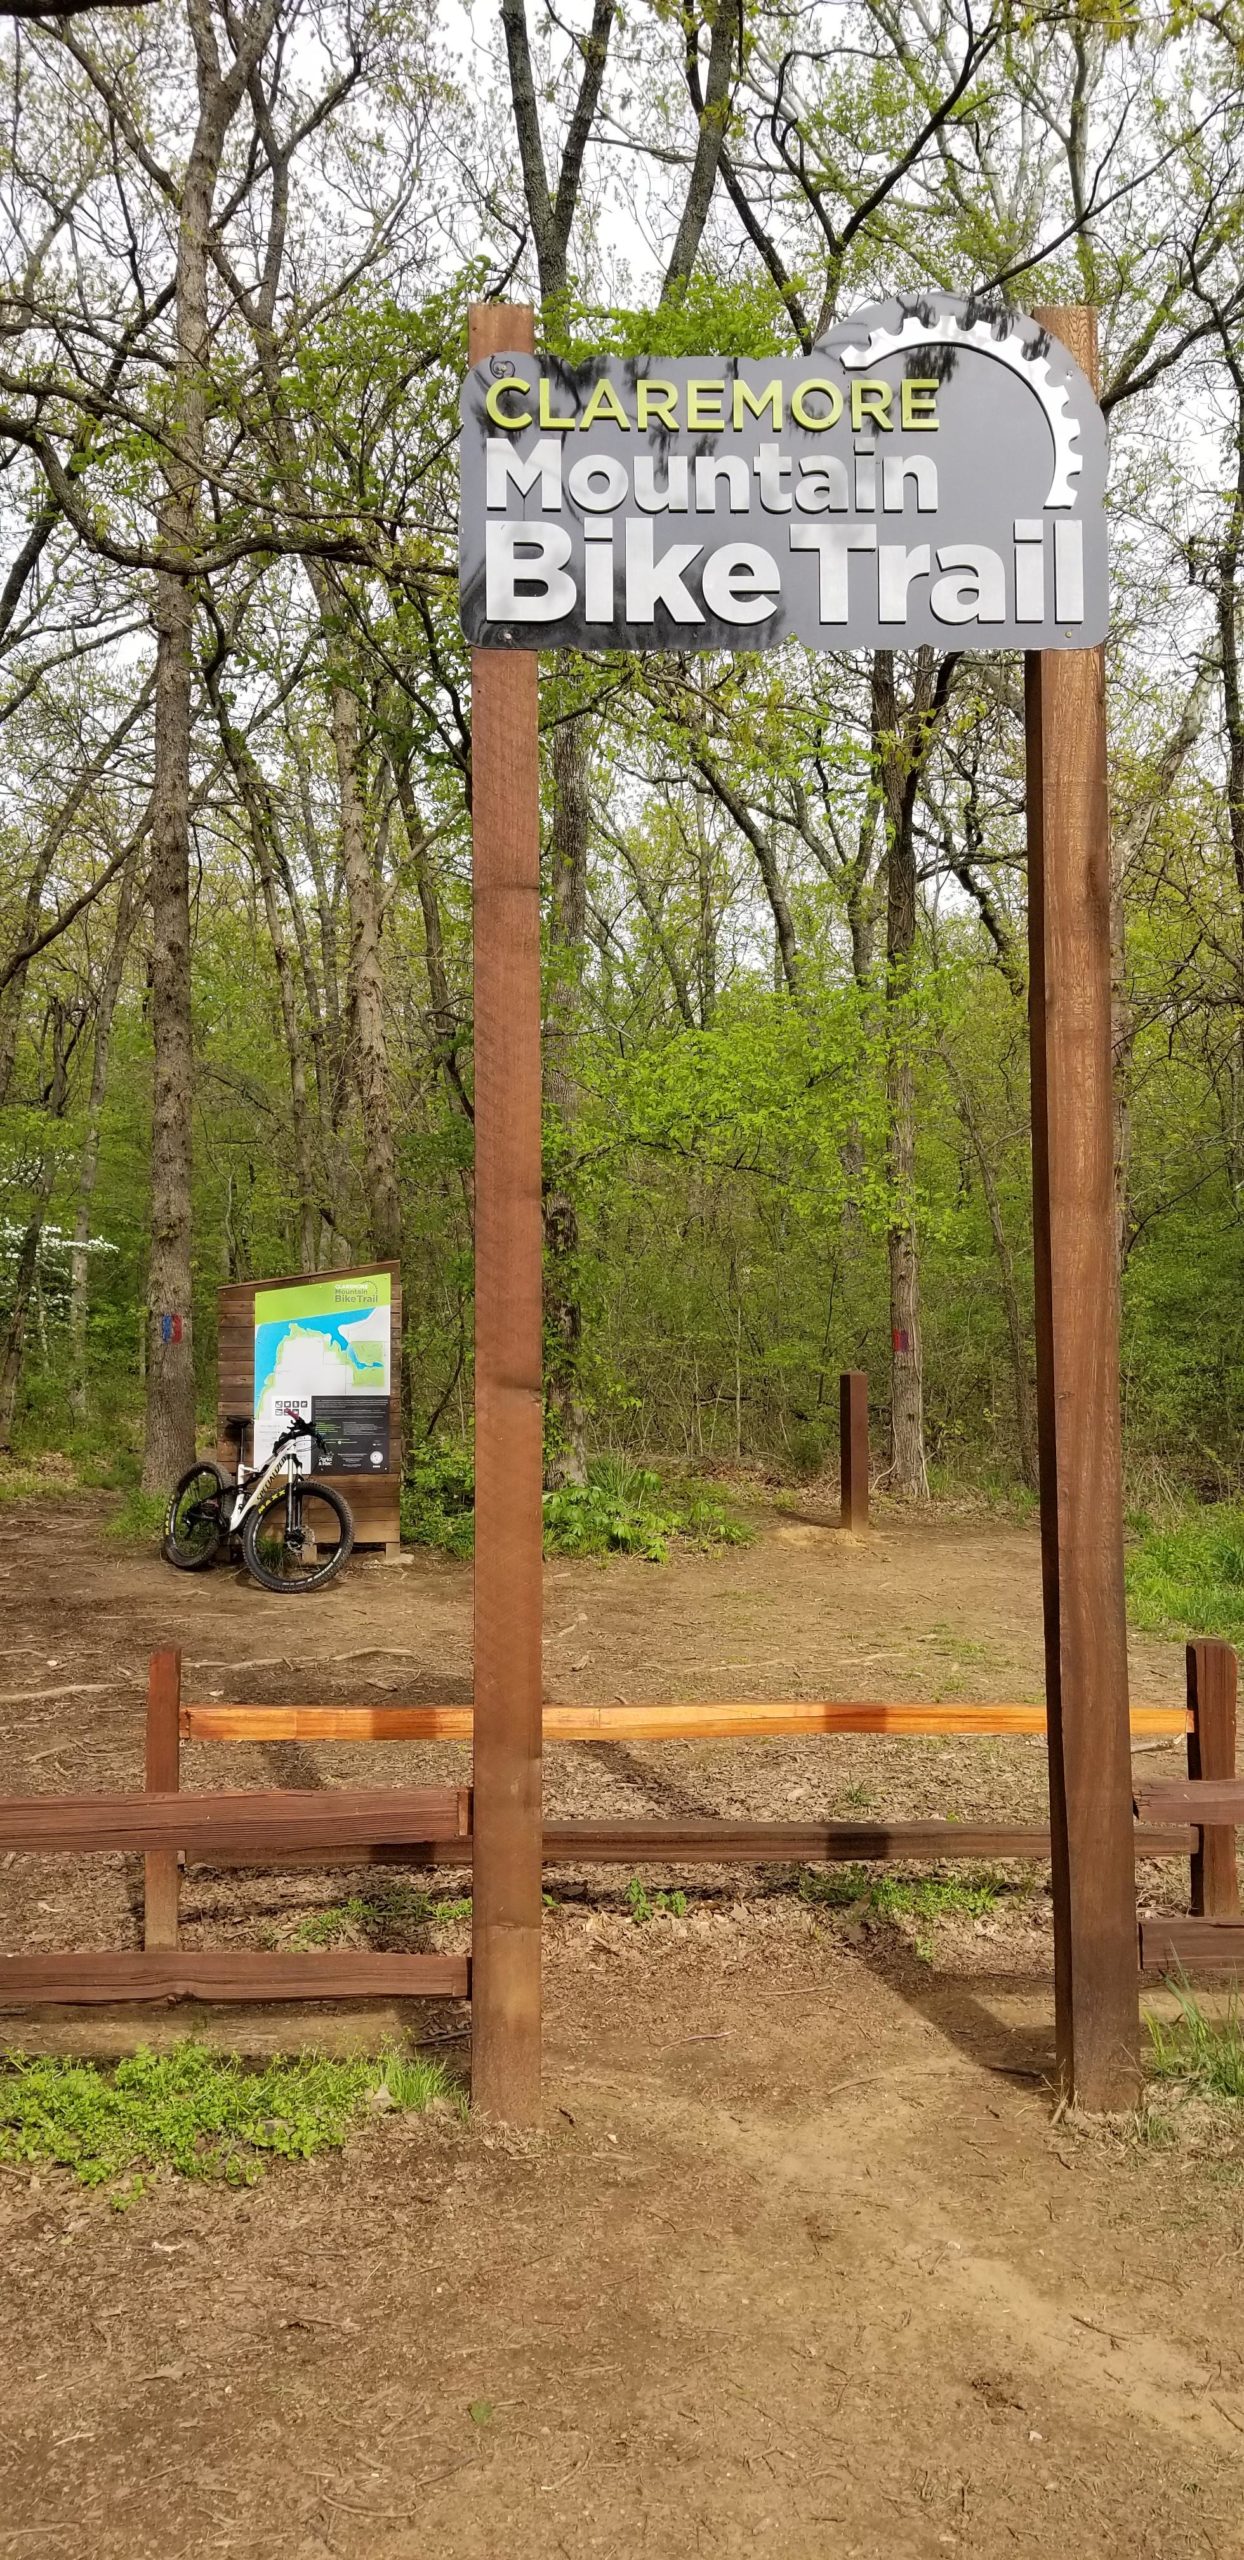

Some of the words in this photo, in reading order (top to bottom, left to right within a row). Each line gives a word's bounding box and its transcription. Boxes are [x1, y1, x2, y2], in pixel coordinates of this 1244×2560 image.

[485, 378, 940, 432] CLAREMORE
[485, 437, 939, 513] Mountain
[485, 517, 782, 625] Bike
[789, 519, 1085, 624] Trail
[335, 1295, 356, 1303] Bike
[357, 1294, 378, 1303] Trail
[258, 1490, 286, 1514] MAXX
